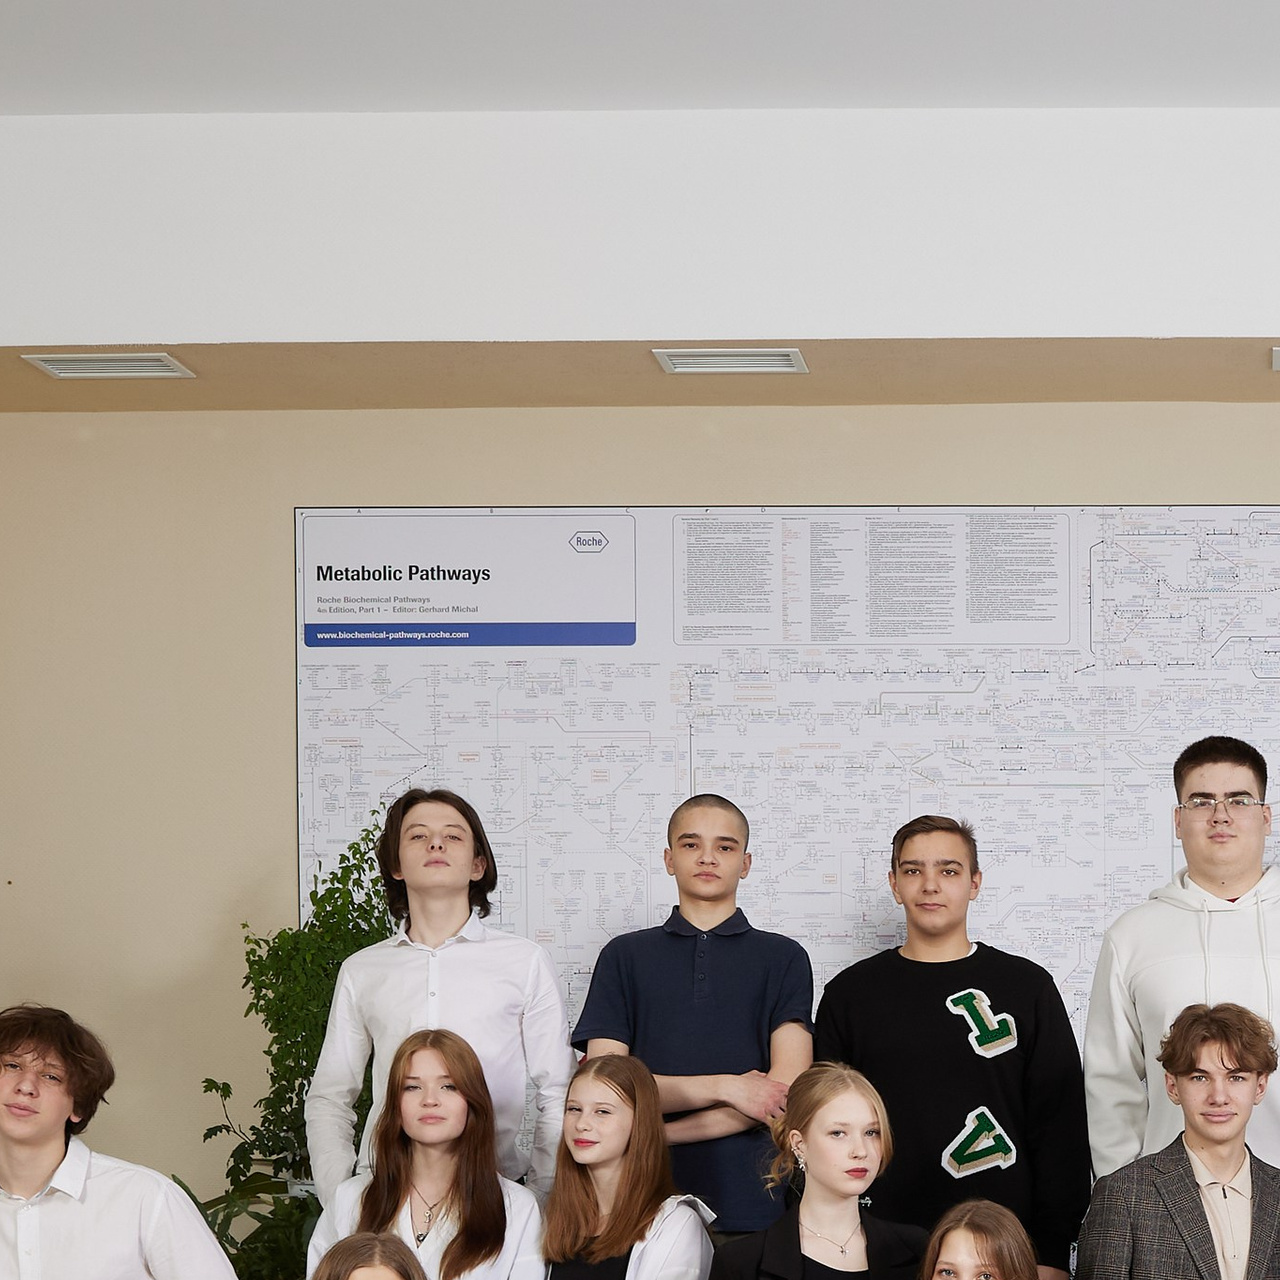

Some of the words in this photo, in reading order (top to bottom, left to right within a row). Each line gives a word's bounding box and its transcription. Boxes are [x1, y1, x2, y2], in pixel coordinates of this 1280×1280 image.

[576, 536, 602, 548] Roche
[316, 565, 403, 582] Metabolic
[408, 565, 491, 584] Pathways
[317, 596, 342, 604] Roche
[343, 596, 392, 604] Biochemical
[393, 596, 431, 606] Pathways
[328, 607, 357, 615] Edition,
[392, 606, 418, 614] Editor:
[418, 606, 450, 614] Gerhard
[451, 606, 479, 614] Michal
[317, 630, 470, 641] www.biochemical-pathways.roche.com
[949, 990, 1015, 1053] L
[946, 1110, 1014, 1175] V
